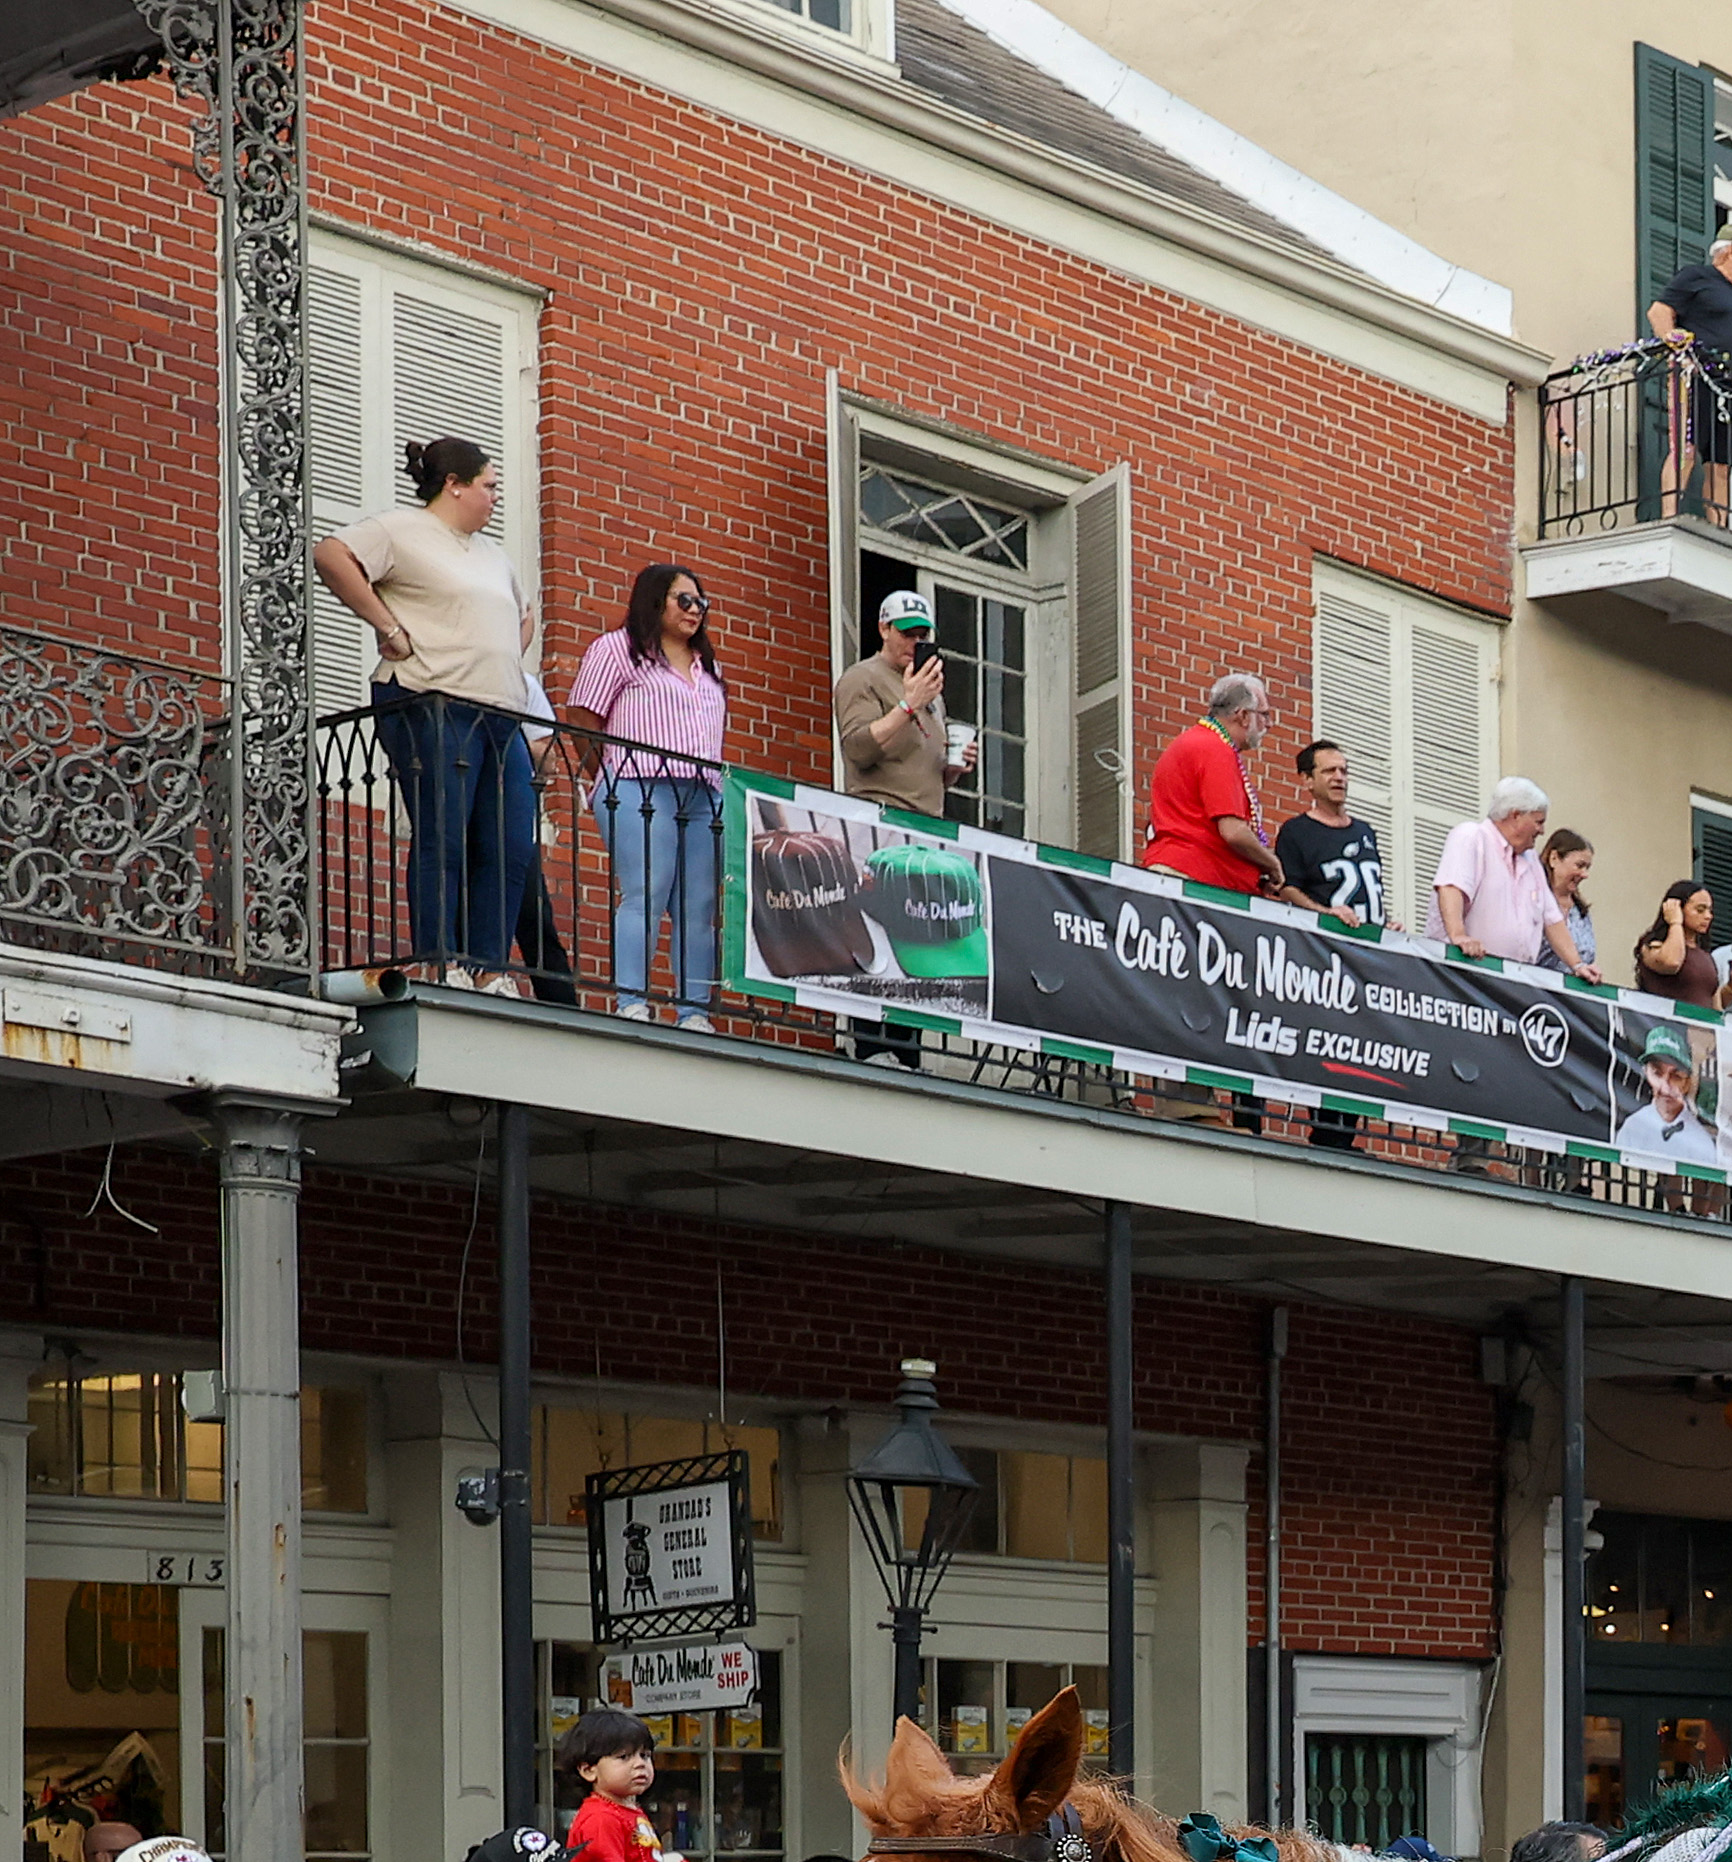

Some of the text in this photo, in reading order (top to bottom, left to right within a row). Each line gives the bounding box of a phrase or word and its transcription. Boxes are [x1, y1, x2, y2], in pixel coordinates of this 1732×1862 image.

[1320, 859, 1385, 925] 26
[1053, 910, 1108, 950] THE
[1115, 901, 1190, 979] Café
[1197, 920, 1249, 990] Du
[1255, 934, 1359, 1014] Monde
[1365, 983, 1499, 1036] COLLECTION
[1225, 1007, 1431, 1077] Lids EXCLUSIVE
[664, 1527, 707, 1552] GENERAL
[156, 1557, 225, 1582] 813
[672, 1556, 702, 1580] STORE
[657, 1653, 675, 1686] Du
[676, 1647, 715, 1683] Monde
[721, 1652, 742, 1669] WE
[717, 1671, 749, 1688] SHIP
